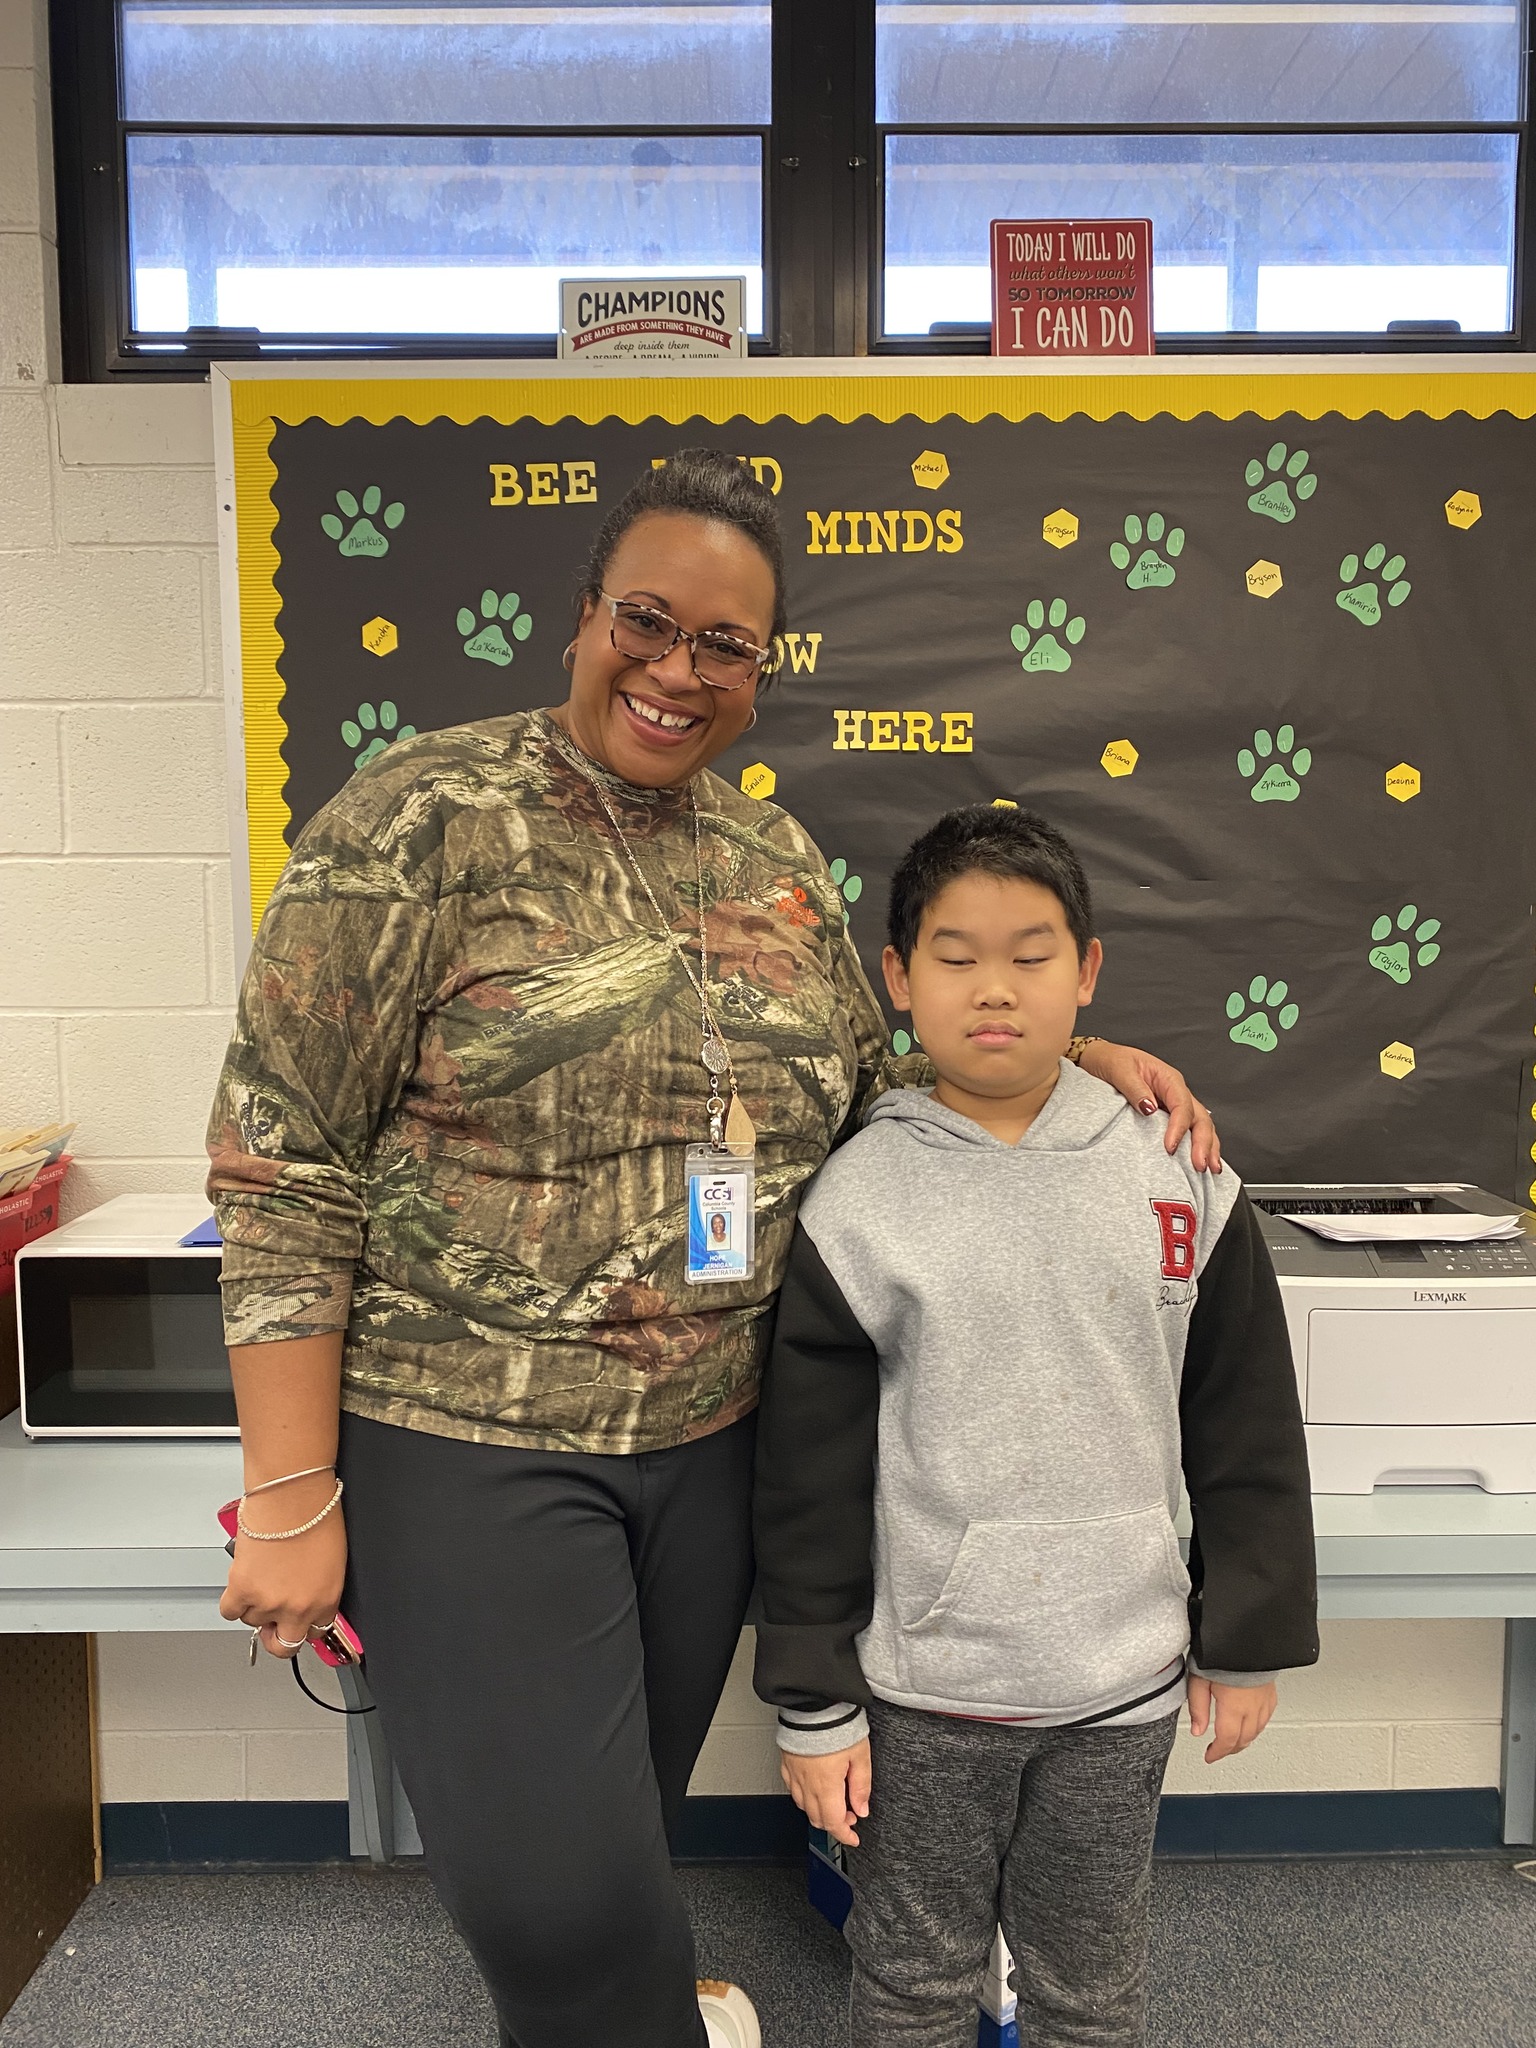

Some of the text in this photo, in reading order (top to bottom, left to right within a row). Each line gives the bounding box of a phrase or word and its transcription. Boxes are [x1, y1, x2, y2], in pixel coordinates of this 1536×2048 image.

[1006, 231, 1136, 262] TODAY I WILL DO
[1009, 263, 1137, 281] what others won't
[1008, 286, 1137, 302] SO TOMORROW
[577, 290, 725, 328] CHAMPIONS
[579, 320, 725, 345] ARE MADE FROM SOMETHING THEY HAVE
[1010, 305, 1134, 349] I CAN DO
[613, 340, 690, 353] deep inside them
[489, 460, 598, 506] BEE
[1257, 493, 1292, 518] Brantley
[806, 508, 965, 555] MINDS
[348, 535, 384, 550] Markus
[1140, 560, 1168, 574] Brayden
[1142, 572, 1152, 583] H.
[1247, 573, 1278, 586] Bryson
[761, 632, 823, 675] OW
[1029, 651, 1050, 666] Eli
[832, 709, 975, 753] HERE
[1104, 747, 1131, 766] Briana
[1374, 950, 1408, 973] Taylor
[33, 1168, 65, 1185] CHOLASTIC
[0, 1197, 30, 1215] HOLASTIC
[1149, 1198, 1196, 1283] B
[691, 1269, 743, 1279] ADMINISTRATION
[1413, 1291, 1467, 1304] LEXMARK
